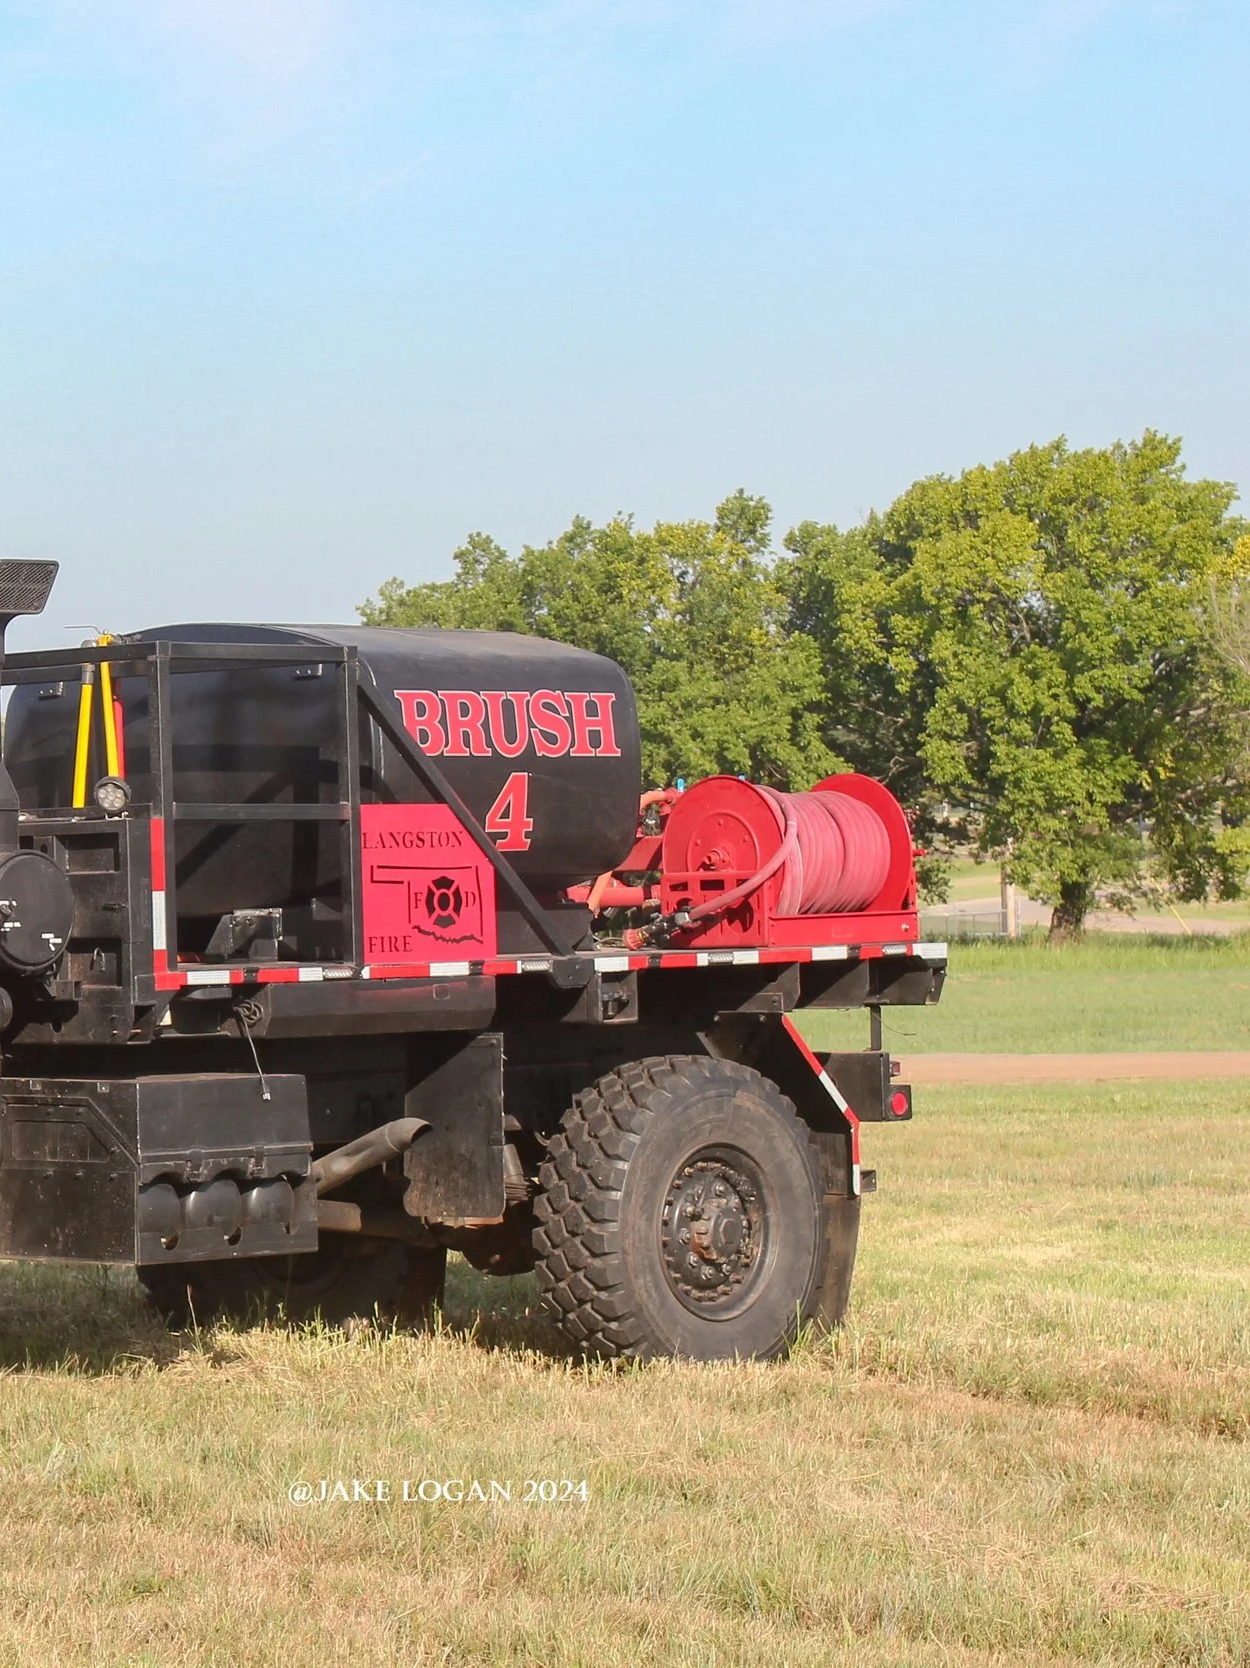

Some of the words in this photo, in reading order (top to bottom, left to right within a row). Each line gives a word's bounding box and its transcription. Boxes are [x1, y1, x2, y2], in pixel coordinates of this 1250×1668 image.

[393, 689, 621, 757] BRUSH
[485, 772, 533, 851] 4
[362, 830, 465, 849] LANGSTON
[413, 891, 423, 909] F
[465, 890, 476, 908] D
[368, 935, 413, 953] FIRE
